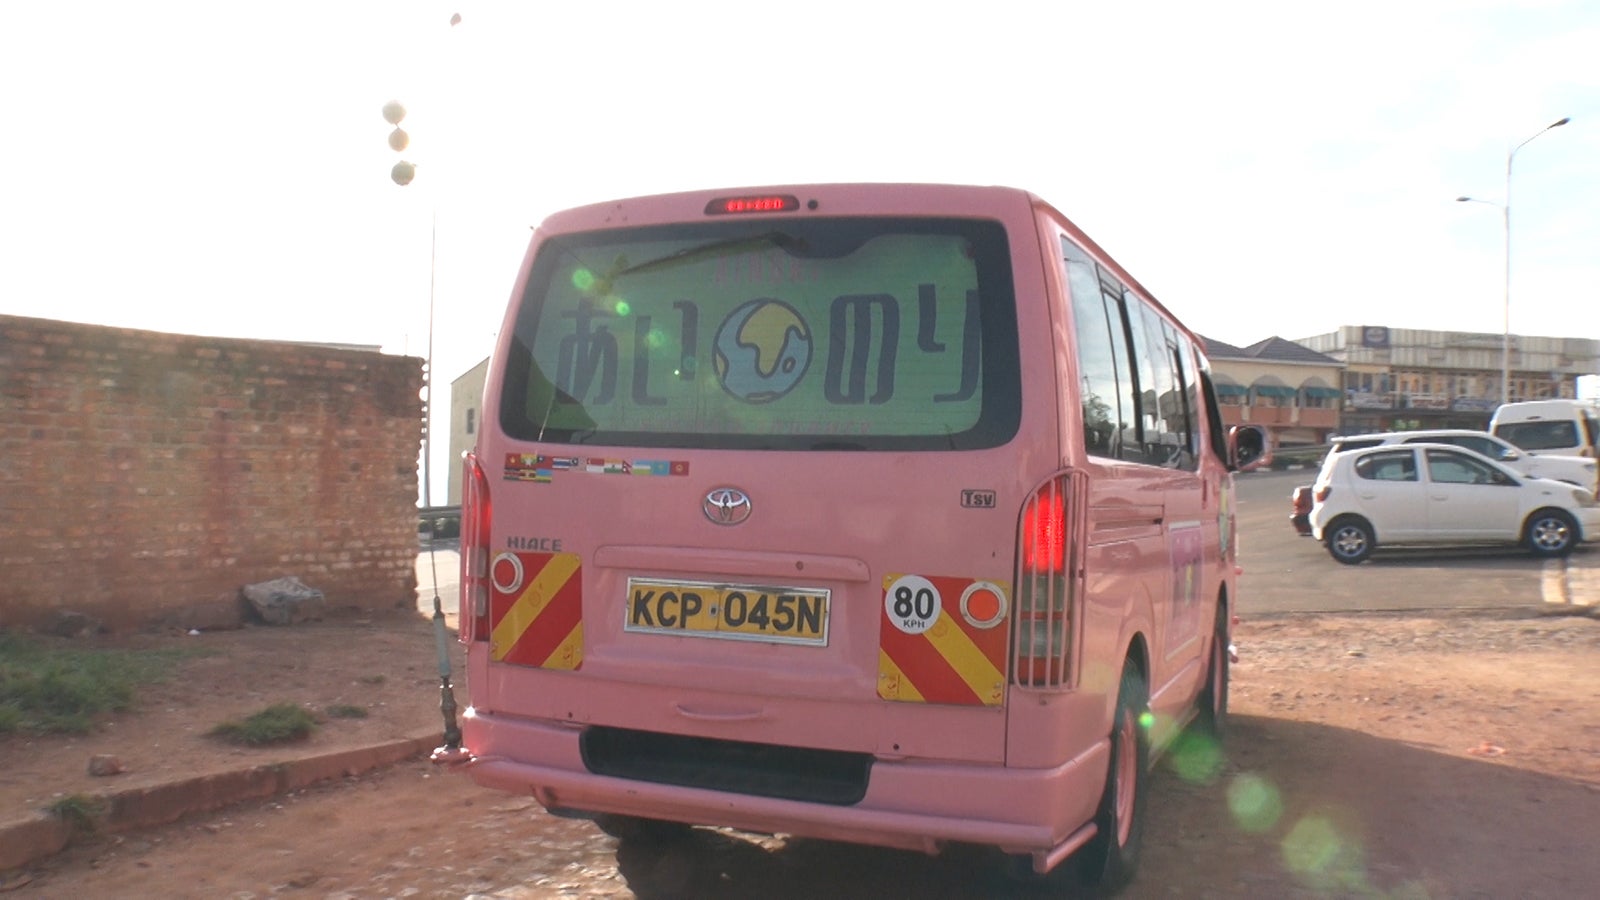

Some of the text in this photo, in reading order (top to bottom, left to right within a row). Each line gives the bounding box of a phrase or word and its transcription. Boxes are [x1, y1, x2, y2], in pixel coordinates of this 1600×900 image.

[507, 537, 563, 551] HIACE
[633, 590, 821, 634] KCP 045N
[893, 586, 934, 619] 80
[903, 619, 925, 629] KPH
